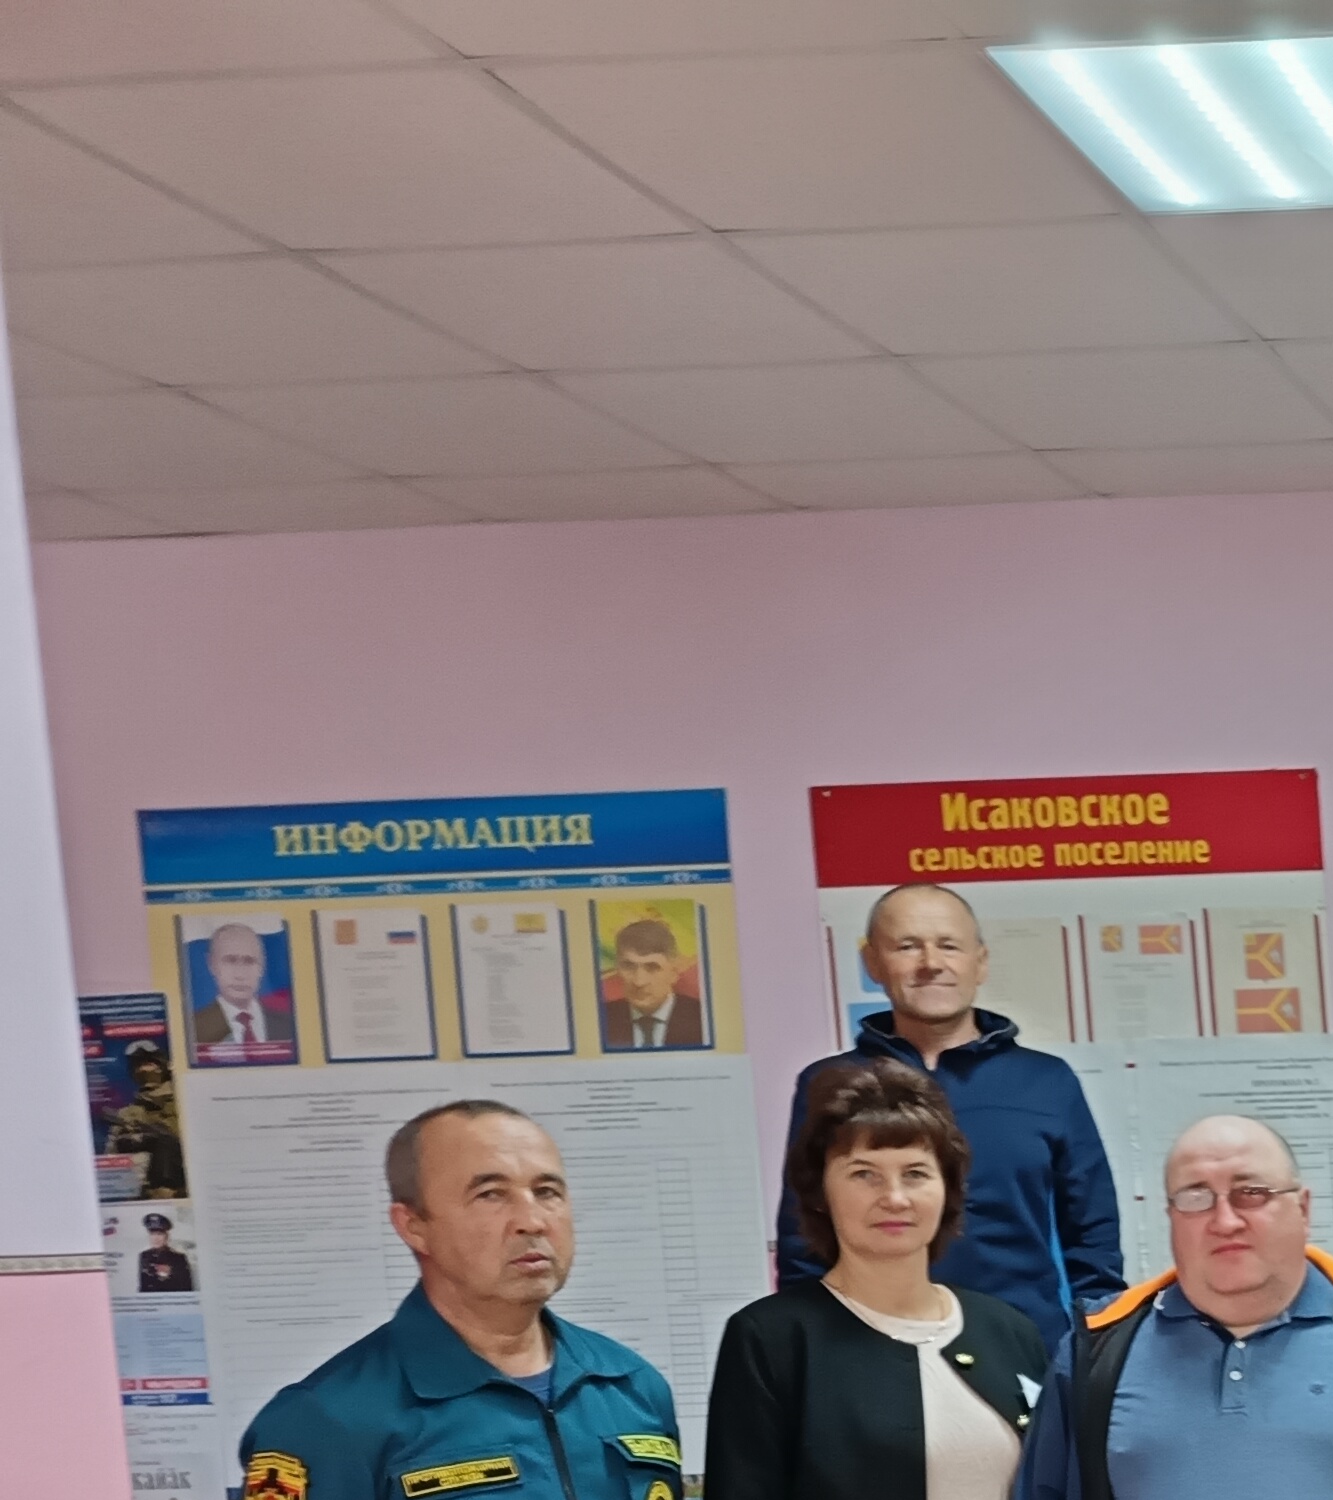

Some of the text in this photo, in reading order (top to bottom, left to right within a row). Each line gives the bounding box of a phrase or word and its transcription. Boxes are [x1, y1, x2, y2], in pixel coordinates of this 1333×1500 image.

[940, 792, 1171, 832] Исаковское
[271, 813, 595, 857] ИНФОРМАЦИЯ
[908, 839, 1212, 872] сельское поселение
